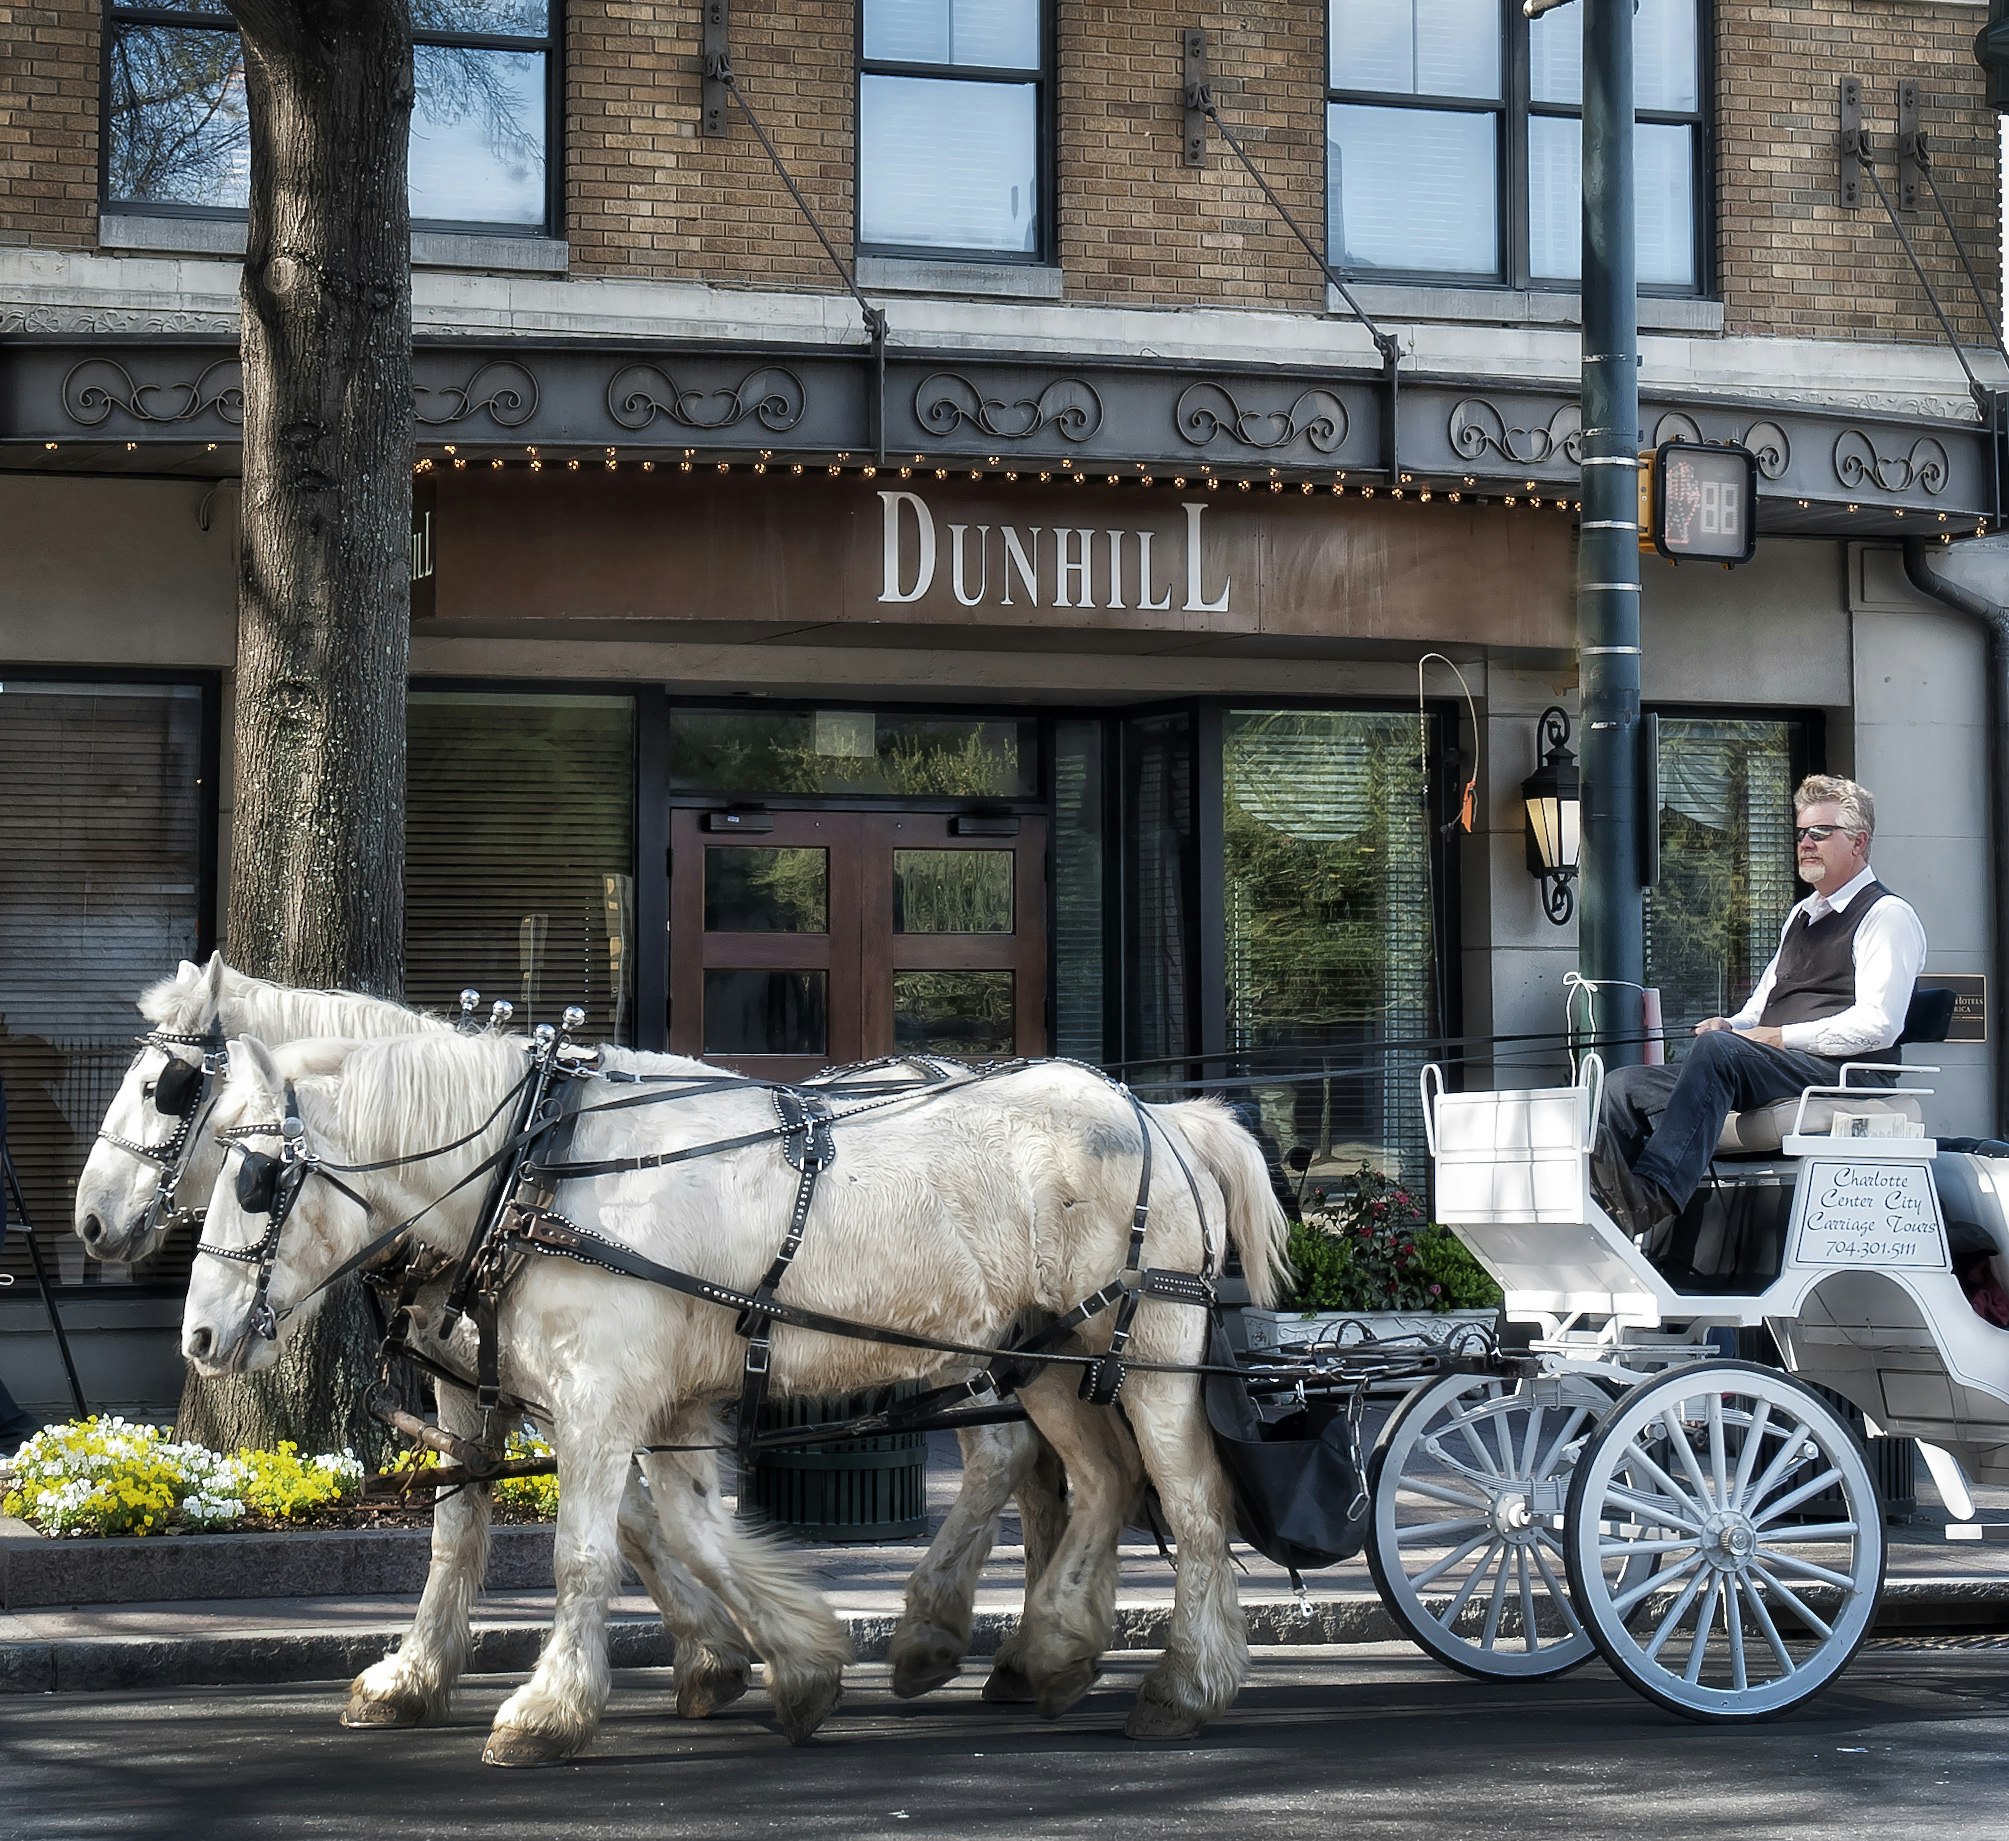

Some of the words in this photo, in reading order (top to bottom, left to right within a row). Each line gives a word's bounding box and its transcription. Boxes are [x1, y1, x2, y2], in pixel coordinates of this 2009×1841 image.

[877, 490, 1231, 612] DUNHILL
[1834, 1167, 1908, 1187] Charlotte
[1820, 1188, 1874, 1208] Center
[1884, 1190, 1922, 1215] City
[1807, 1211, 1875, 1237] Carriage
[1886, 1214, 1937, 1234] Tours
[1826, 1240, 1916, 1259] 704.301.5111
